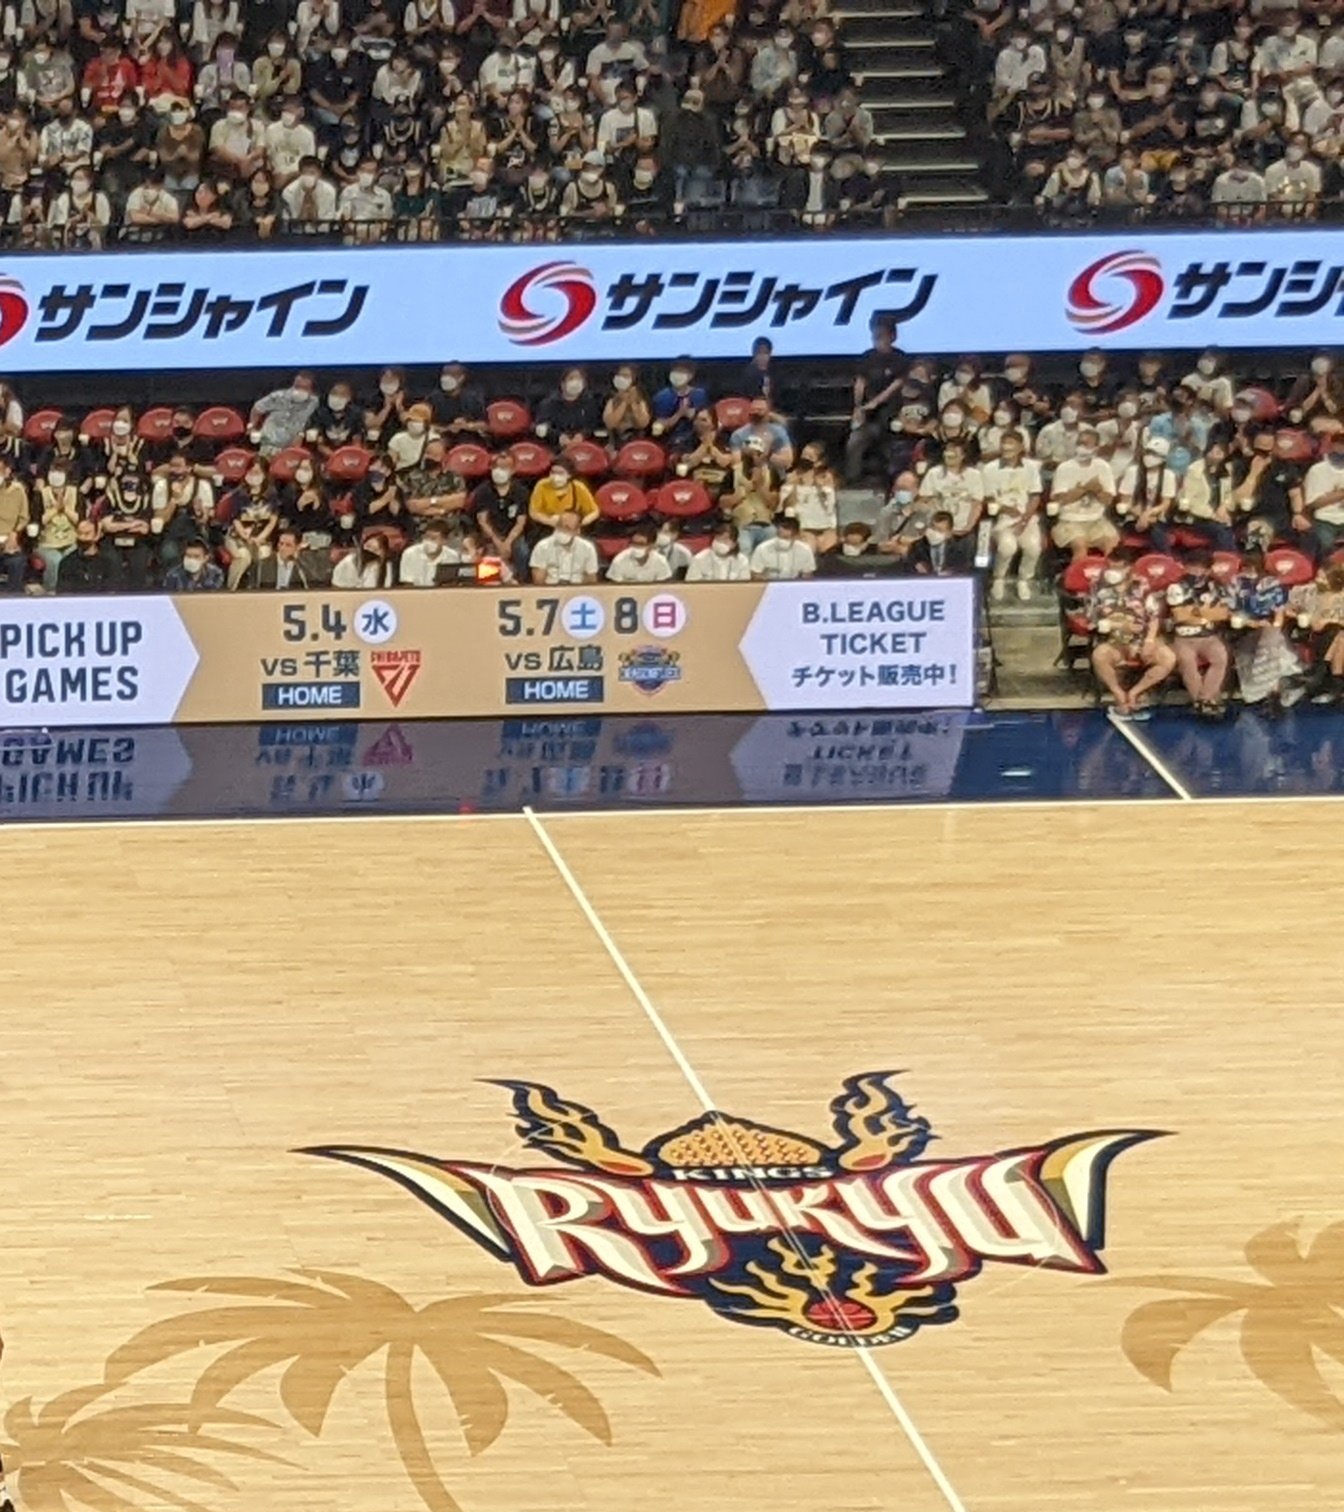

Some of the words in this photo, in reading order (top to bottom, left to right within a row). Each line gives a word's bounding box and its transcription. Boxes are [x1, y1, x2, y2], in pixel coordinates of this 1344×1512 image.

[602, 268, 938, 331] サンシャイン
[1167, 260, 1344, 319] サンシ
[33, 277, 368, 343] サンシャイン
[282, 604, 346, 642] 5.4
[360, 608, 391, 636] 水
[498, 597, 560, 636] 5.7
[569, 604, 598, 630] 土
[614, 596, 639, 634] 8
[652, 603, 677, 629] 日
[802, 599, 945, 624] B.LEAGUE
[0, 622, 86, 659] PICK
[95, 621, 144, 657] UP
[820, 632, 927, 655] TICKET
[303, 650, 360, 678] 千葉
[549, 645, 604, 671] 広島
[5, 667, 139, 704] GAMES
[277, 686, 343, 705] HOME
[523, 680, 589, 700] HOME
[672, 1165, 835, 1181] KINGS
